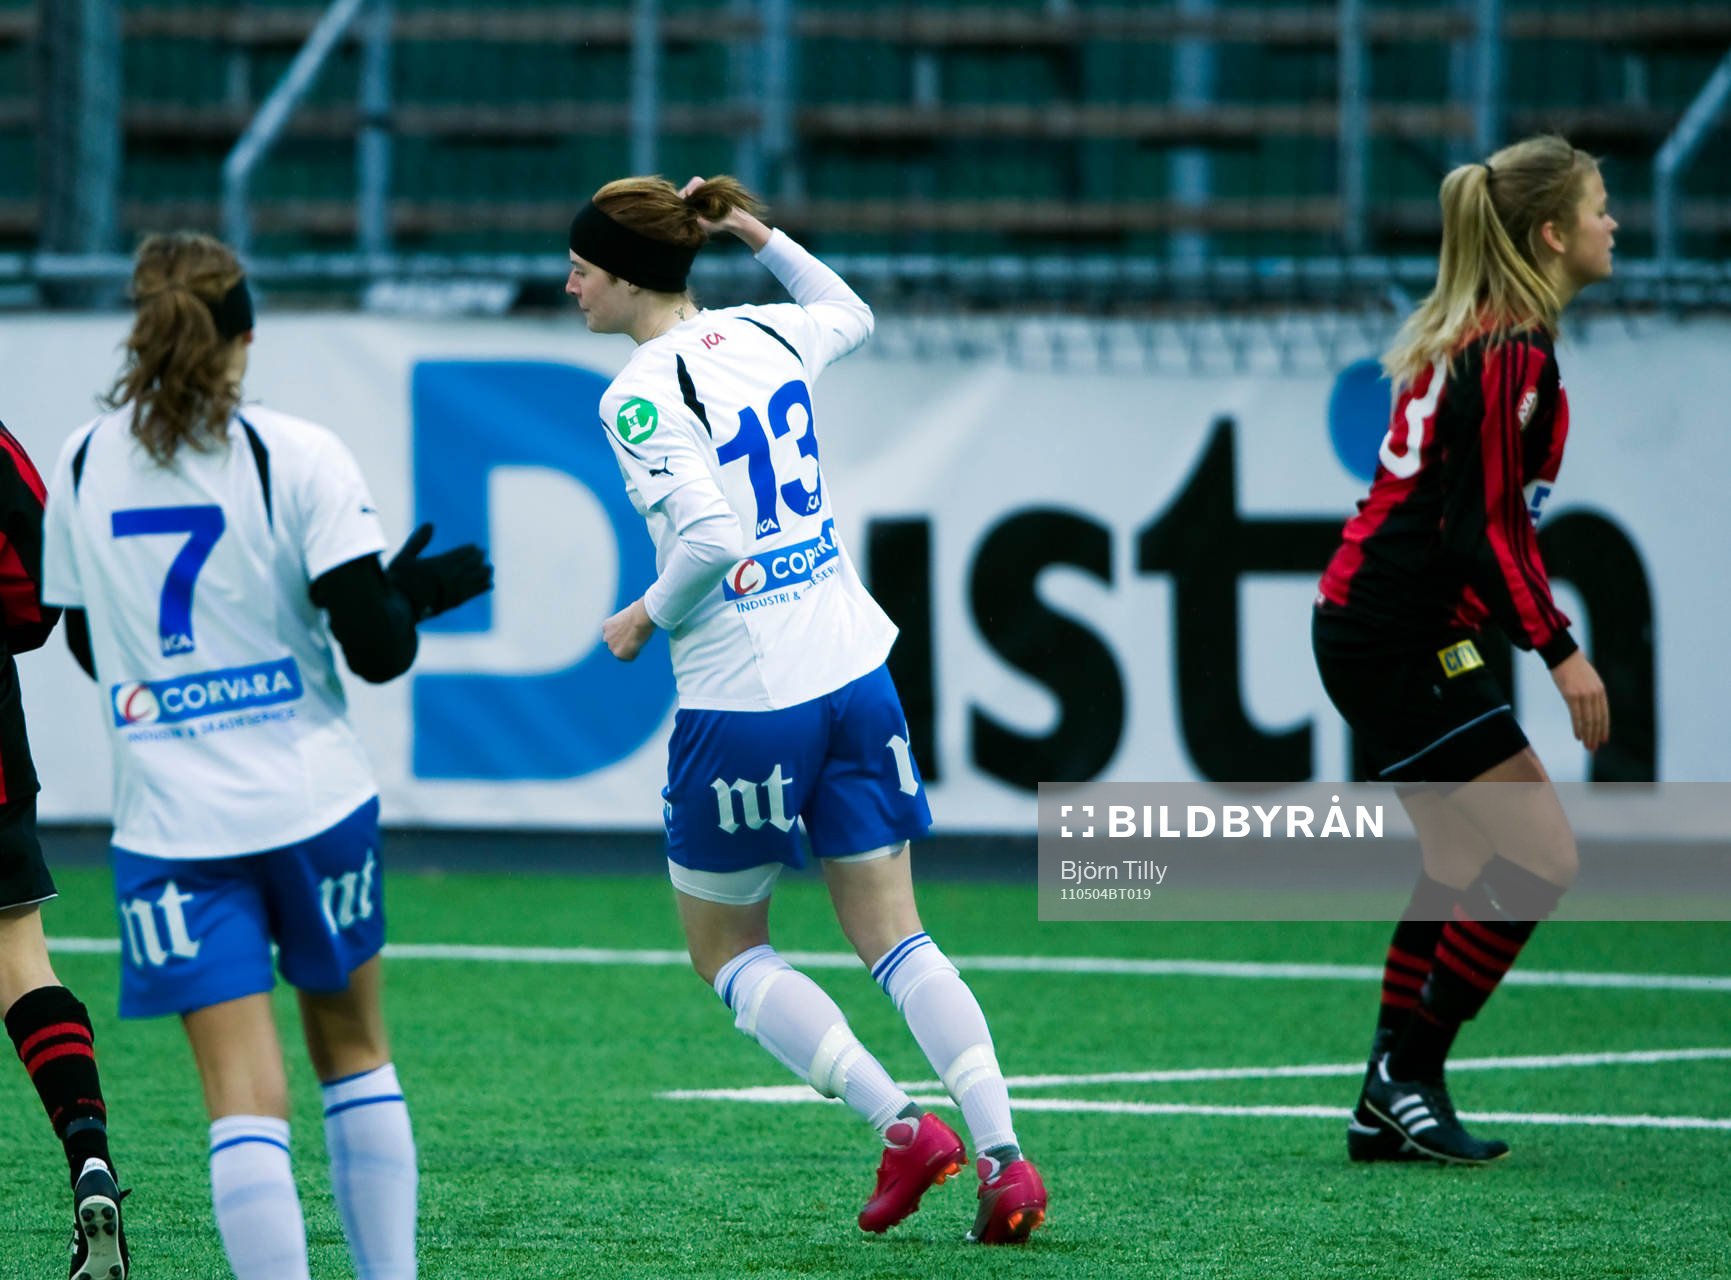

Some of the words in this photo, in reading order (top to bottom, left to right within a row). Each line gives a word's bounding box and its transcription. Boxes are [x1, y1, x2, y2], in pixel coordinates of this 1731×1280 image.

[715, 379, 823, 540] 13
[756, 517, 779, 536] ICA
[111, 504, 226, 657] 7
[735, 593, 791, 613] INDUSTRI
[161, 669, 293, 713] CORVARA
[710, 763, 794, 835] nt
